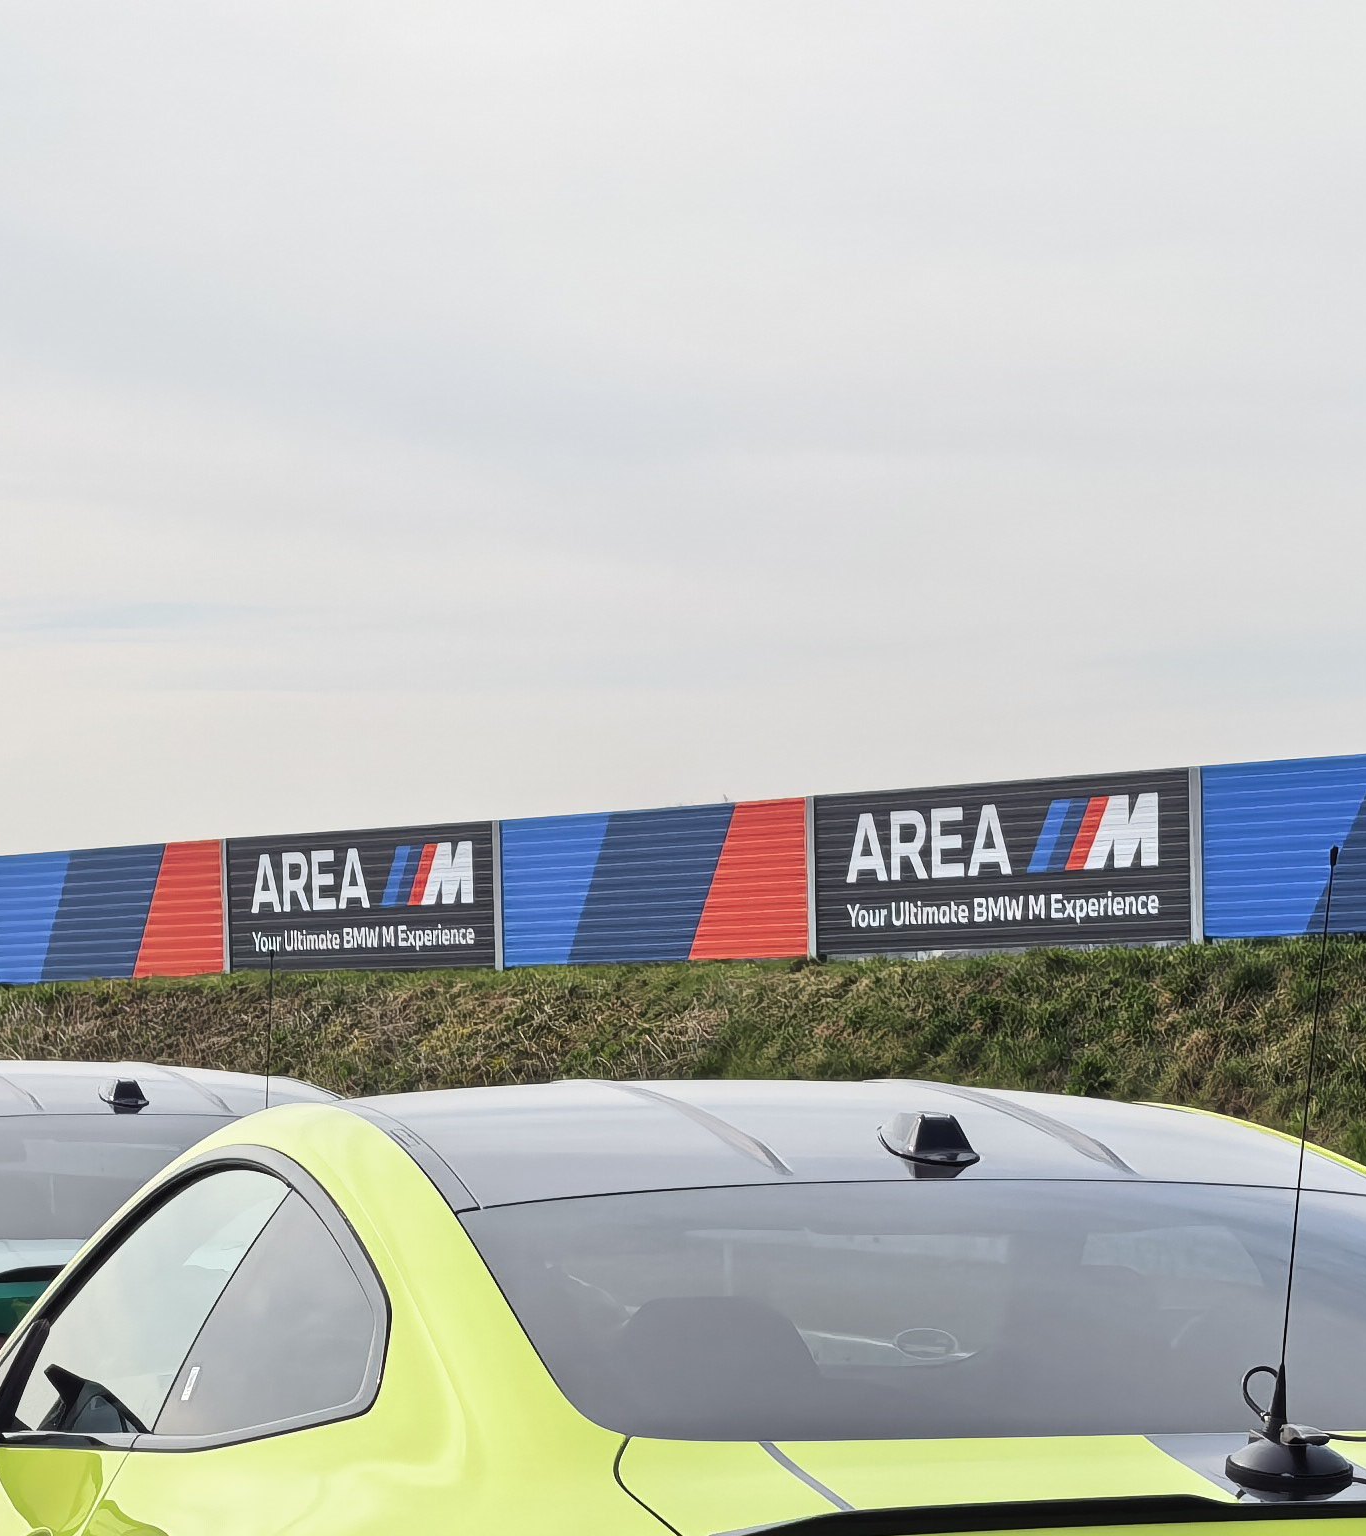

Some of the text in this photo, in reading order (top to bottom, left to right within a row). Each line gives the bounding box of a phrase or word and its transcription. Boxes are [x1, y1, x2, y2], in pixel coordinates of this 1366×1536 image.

[846, 804, 1012, 883] AREA
[251, 848, 370, 914] AREA
[847, 891, 1159, 928] Your Ultimate BMW M Experience
[252, 924, 476, 952] Your Ultimate BMW M Experience
